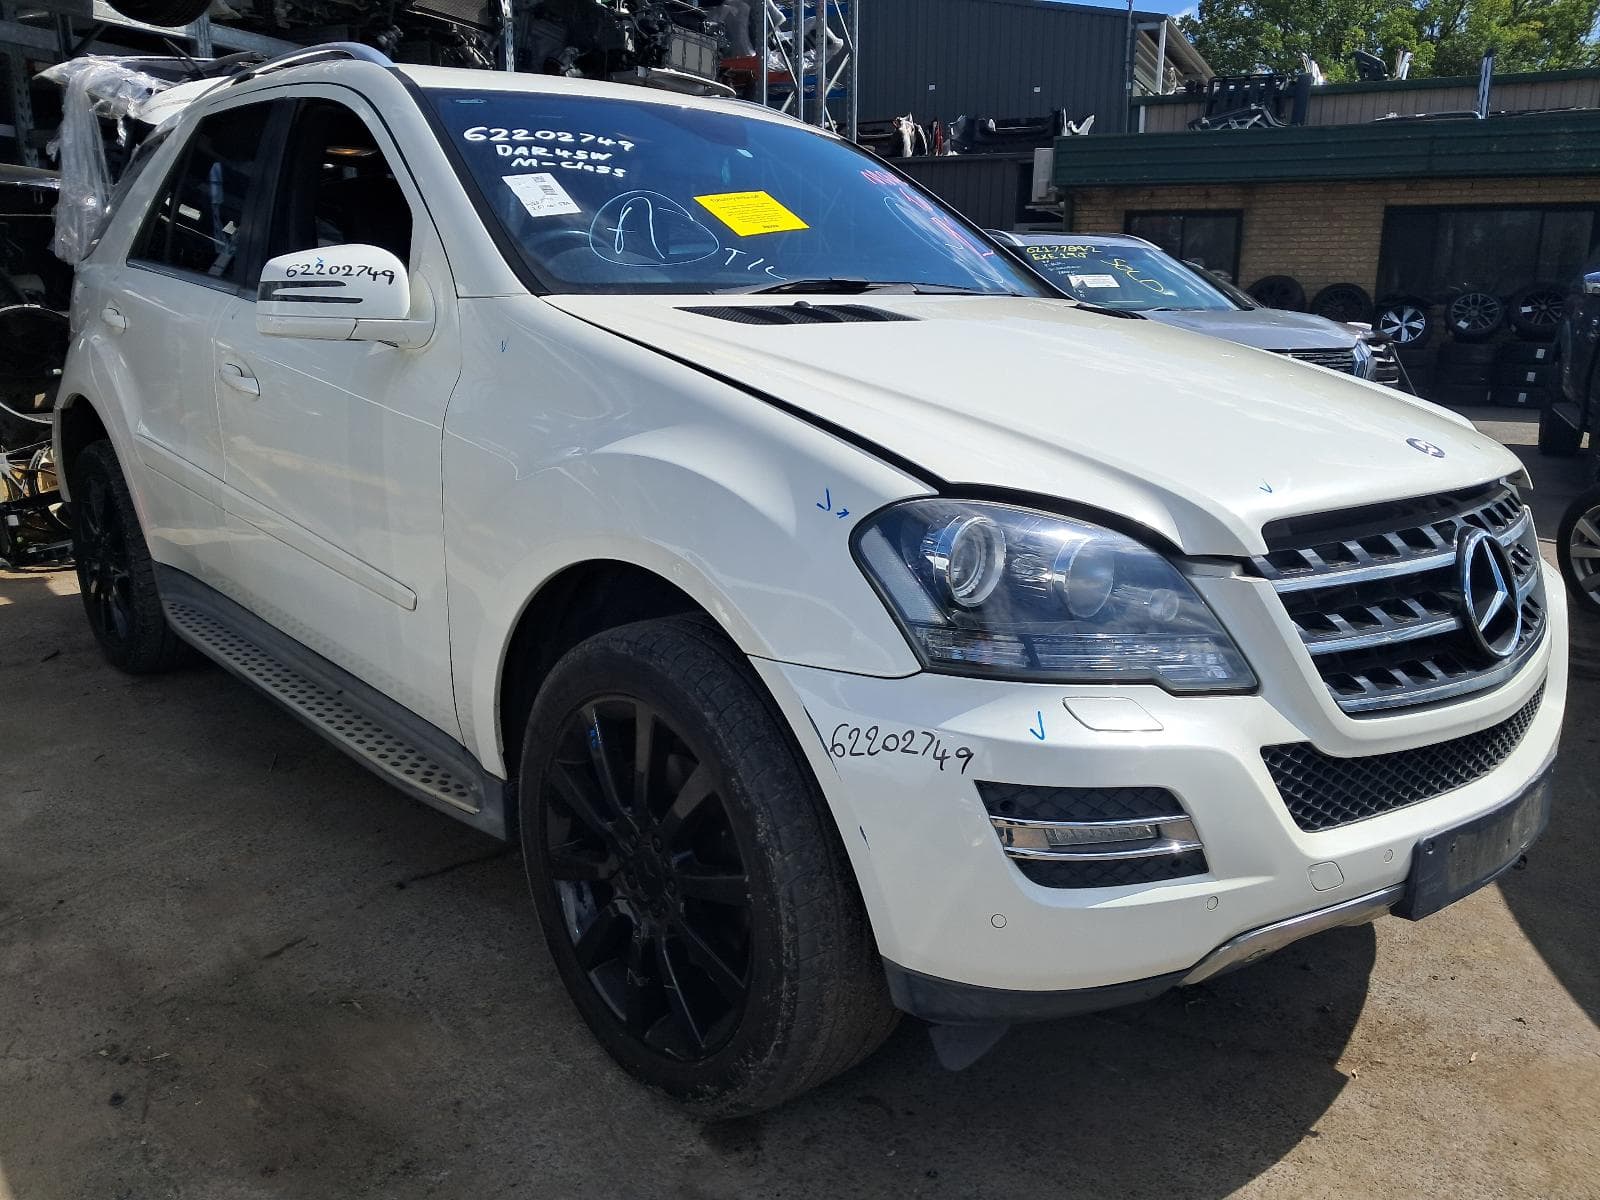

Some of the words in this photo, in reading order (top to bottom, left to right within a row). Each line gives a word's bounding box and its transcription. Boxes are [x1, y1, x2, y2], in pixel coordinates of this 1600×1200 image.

[463, 126, 635, 151] 62202749
[286, 263, 395, 285] 62202749
[829, 723, 975, 775] 62202749
